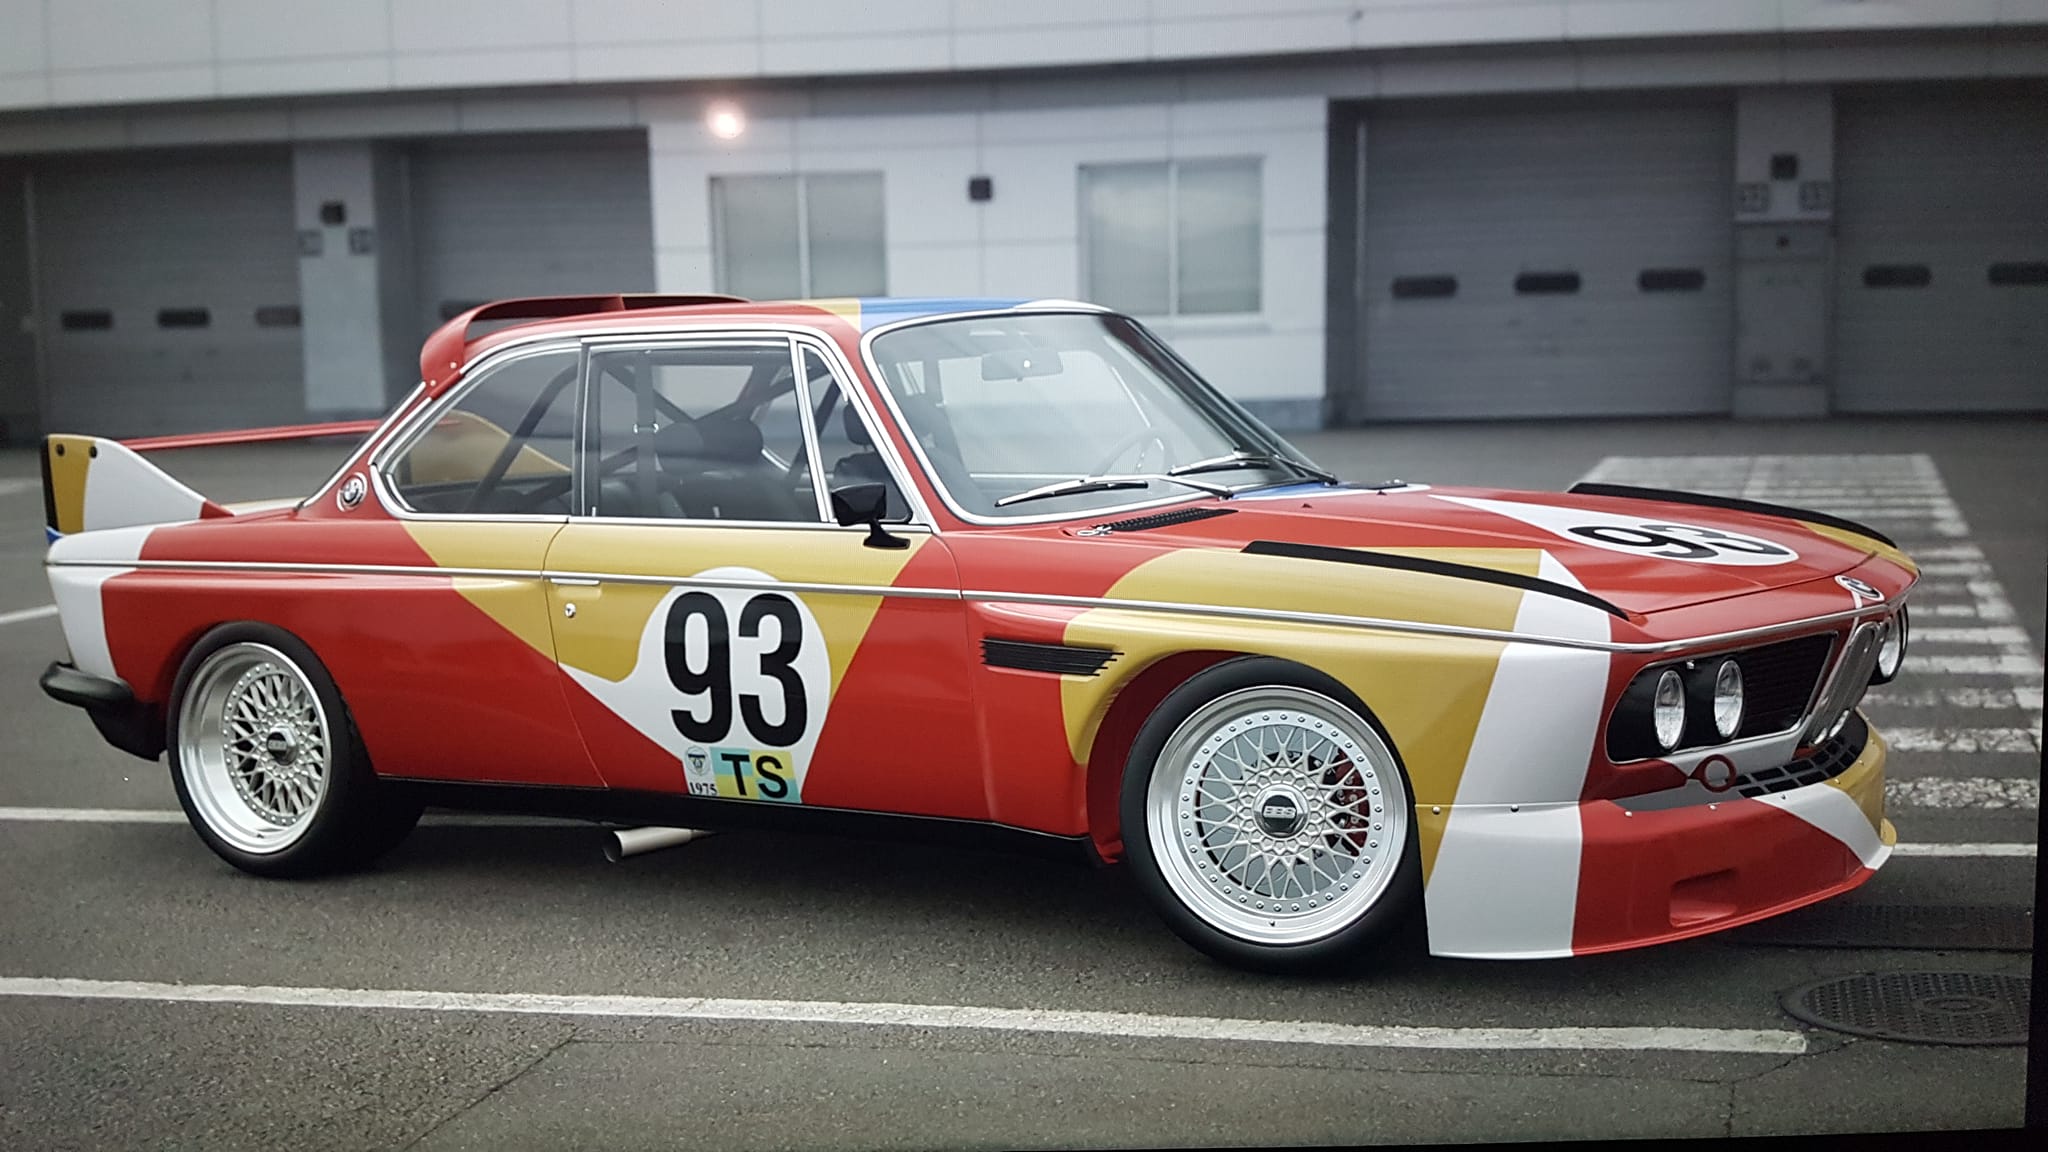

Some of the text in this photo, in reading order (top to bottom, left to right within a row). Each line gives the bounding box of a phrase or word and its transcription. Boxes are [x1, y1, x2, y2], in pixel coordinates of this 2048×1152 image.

[1568, 525, 1790, 559] 93
[664, 591, 807, 747] 93
[690, 782, 718, 796] 1975
[721, 753, 788, 799] TS
